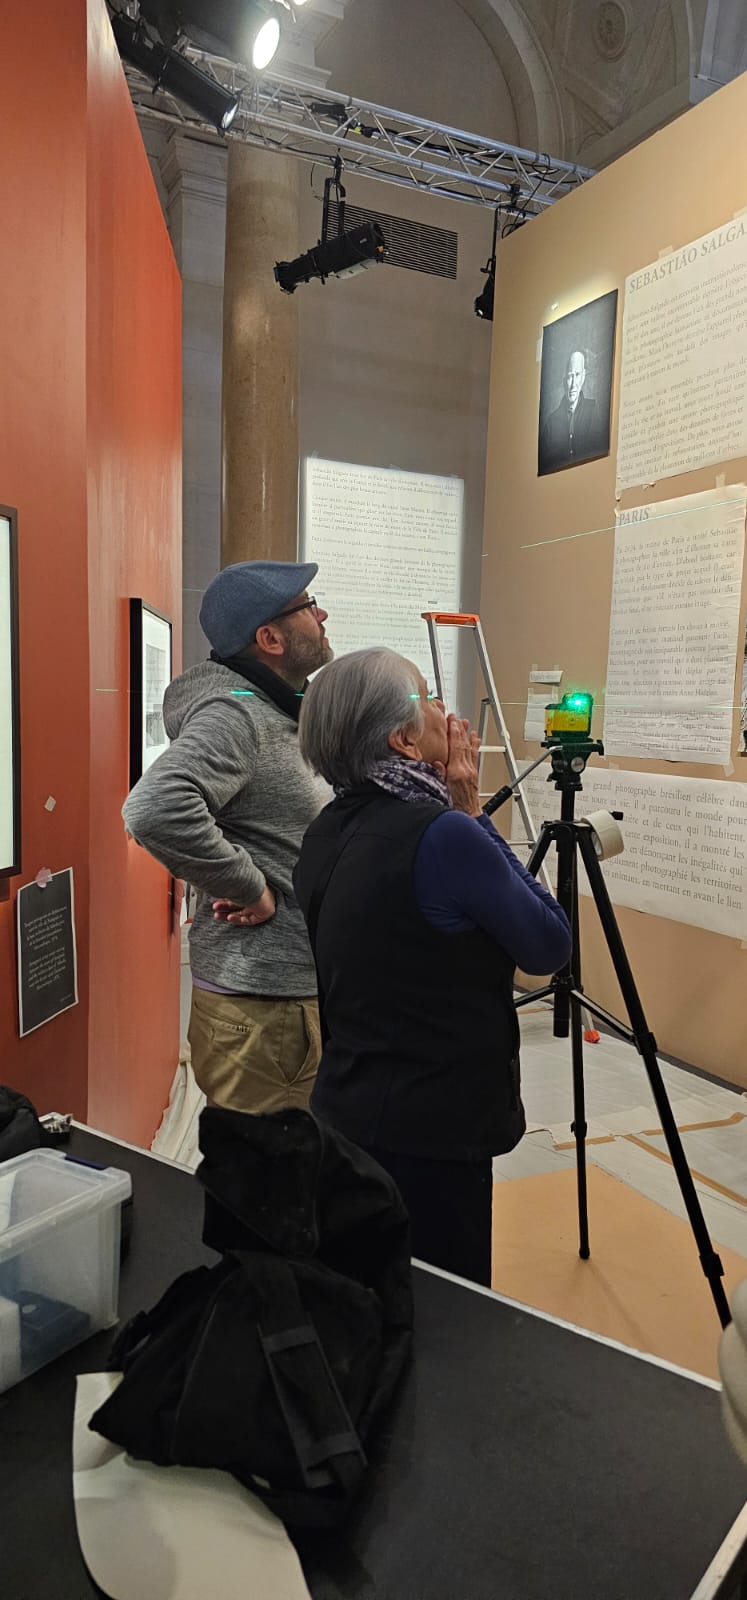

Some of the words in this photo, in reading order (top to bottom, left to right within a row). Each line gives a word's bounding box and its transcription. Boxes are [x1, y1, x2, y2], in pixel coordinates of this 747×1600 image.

[630, 248, 697, 293] SEBASTIÃO
[701, 222, 747, 256] SALGA
[620, 508, 650, 526] PARIS
[616, 784, 656, 798] photographe
[660, 788, 691, 801] brésilien
[696, 793, 724, 805] célèbre
[730, 796, 747, 808] dans
[649, 803, 680, 815] parcouru
[684, 806, 692, 817] le
[696, 810, 723, 822] monde
[727, 815, 747, 826] pour
[643, 817, 648, 826] et
[653, 818, 661, 828] de
[666, 822, 682, 831] ceux
[686, 824, 699, 837] qui
[684, 838, 690, 849] il
[692, 842, 697, 850] a
[701, 844, 730, 856] montré
[734, 847, 744, 859] les
[641, 861, 688, 880] photographié
[691, 872, 700, 883] les
[704, 877, 742, 893] territoires
[678, 853, 688, 864] les
[690, 856, 727, 872] inégalités
[730, 866, 743, 878] qui
[683, 888, 691, 897] en
[693, 893, 715, 904] avant
[717, 894, 725, 905] le
[727, 896, 742, 909] lien
